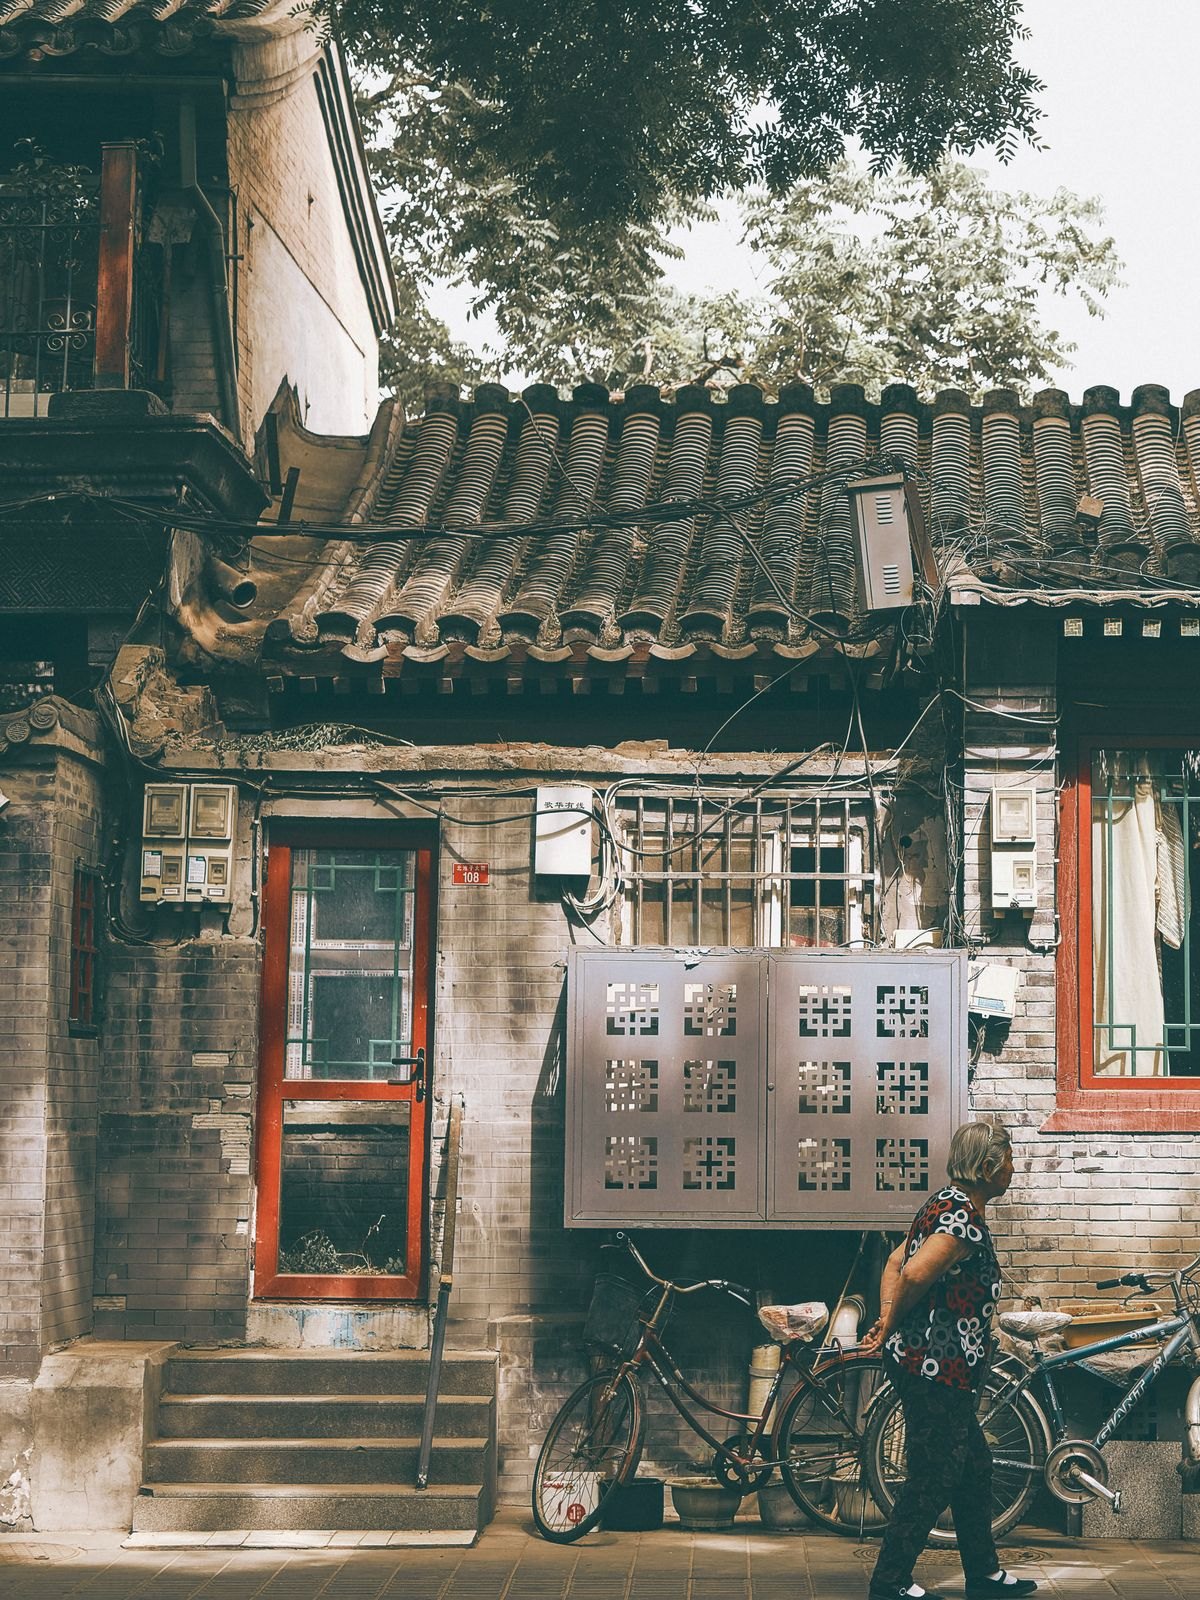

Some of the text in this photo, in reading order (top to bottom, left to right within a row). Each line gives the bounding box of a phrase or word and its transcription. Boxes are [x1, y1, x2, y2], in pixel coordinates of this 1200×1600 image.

[544, 801, 585, 810] 歌华有线
[463, 871, 480, 883] 108
[1096, 1378, 1146, 1445] GIANT
